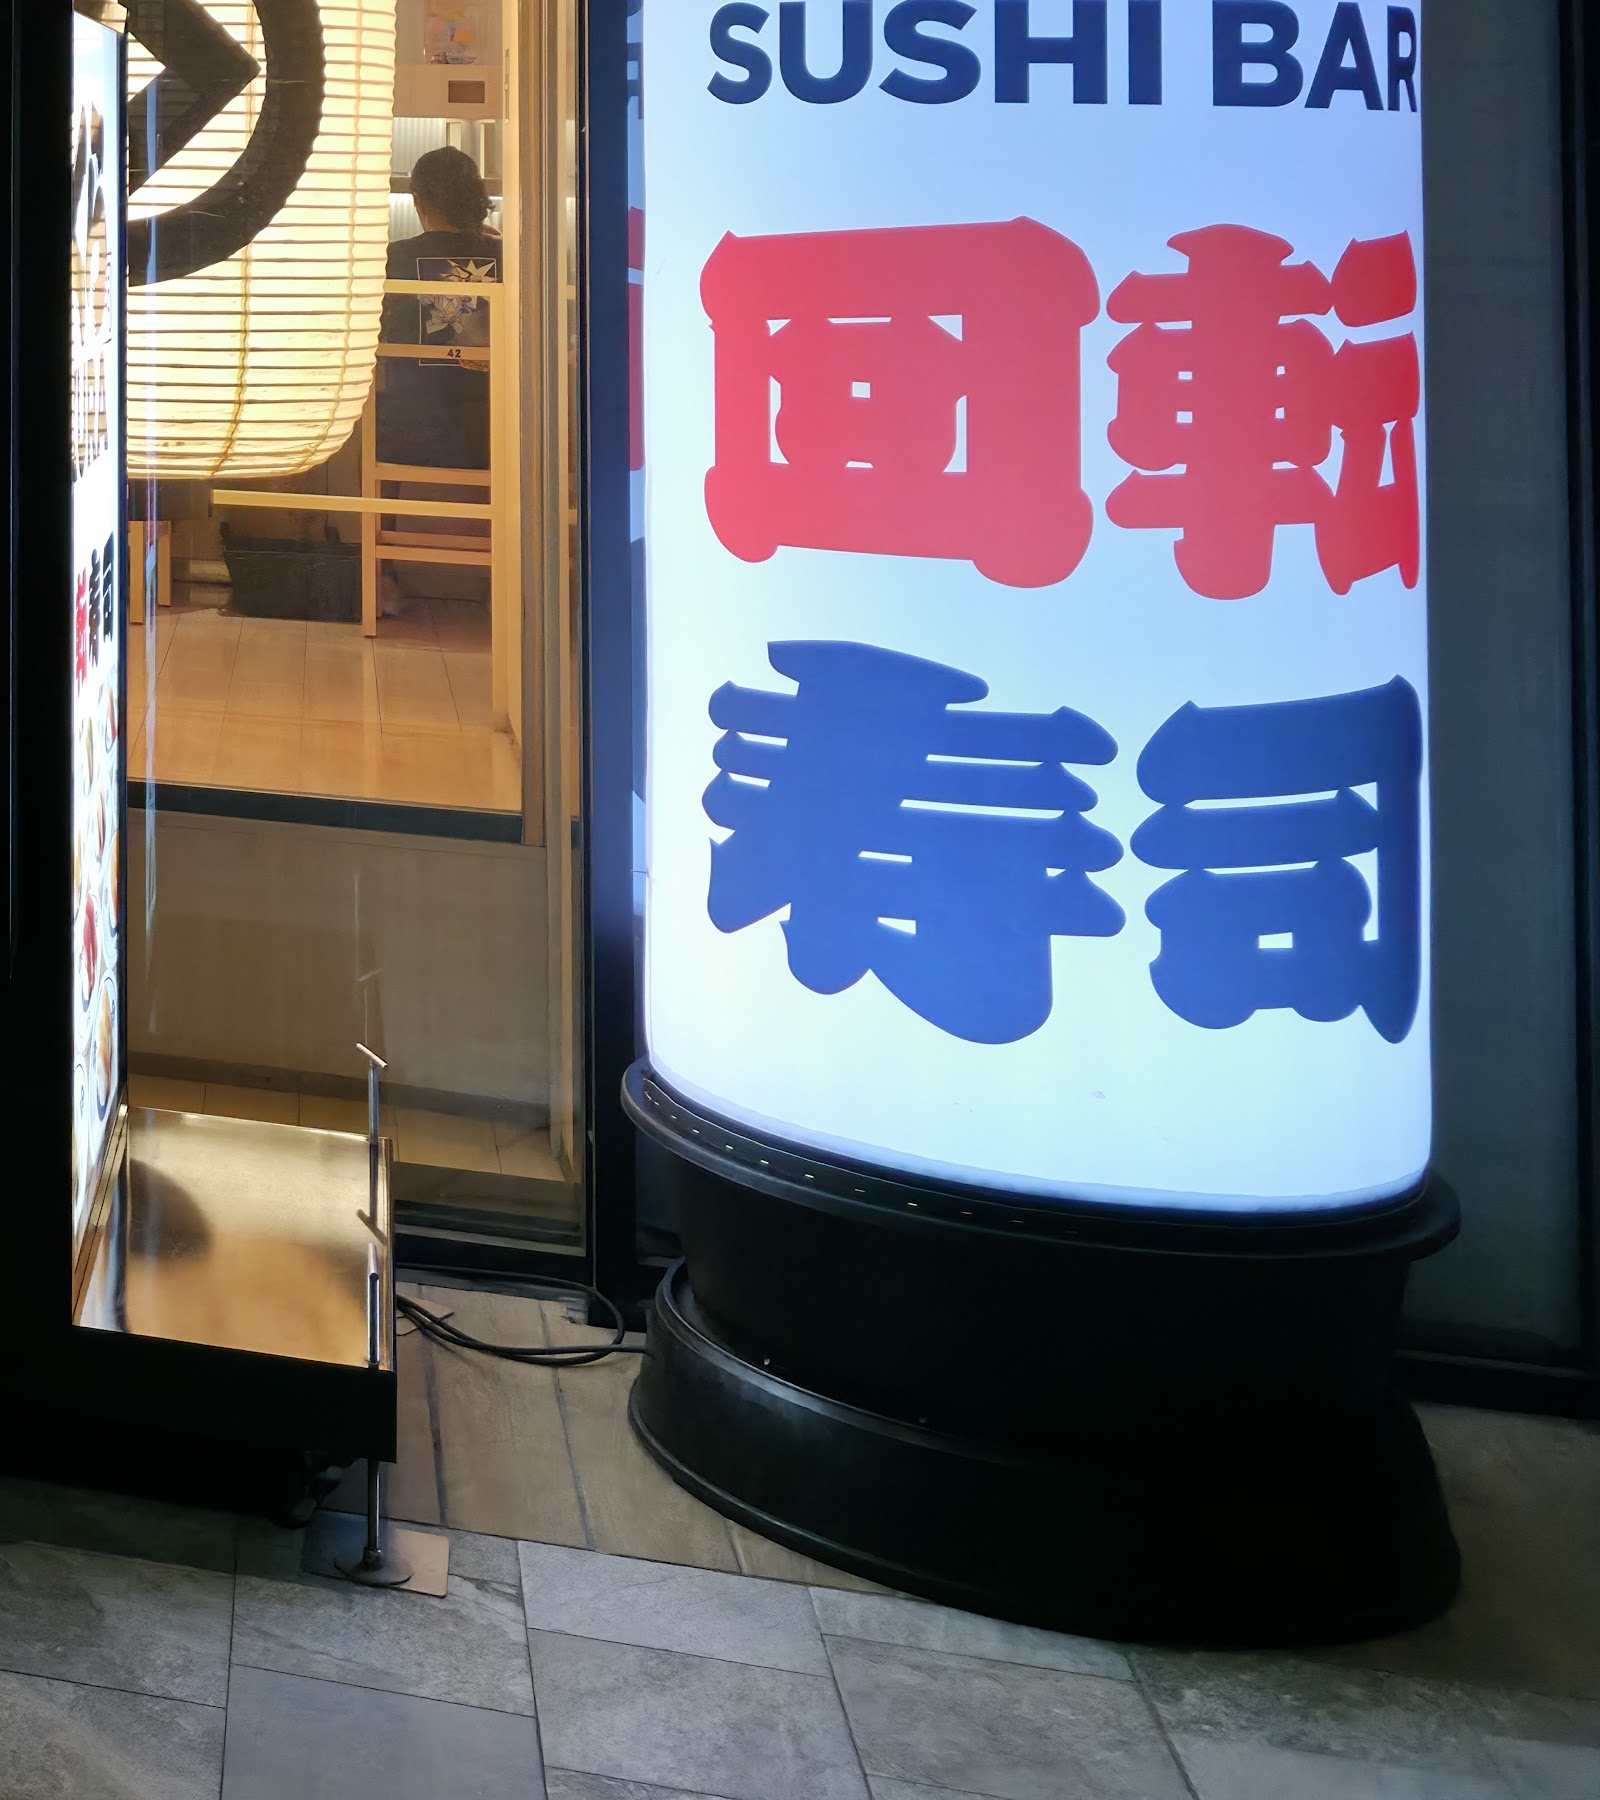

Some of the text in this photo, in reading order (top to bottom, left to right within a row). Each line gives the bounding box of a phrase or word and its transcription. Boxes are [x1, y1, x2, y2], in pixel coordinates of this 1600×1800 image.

[447, 349, 461, 358] 42
[700, 216, 1419, 600] 回転
[703, 640, 1421, 1043] 寿司
